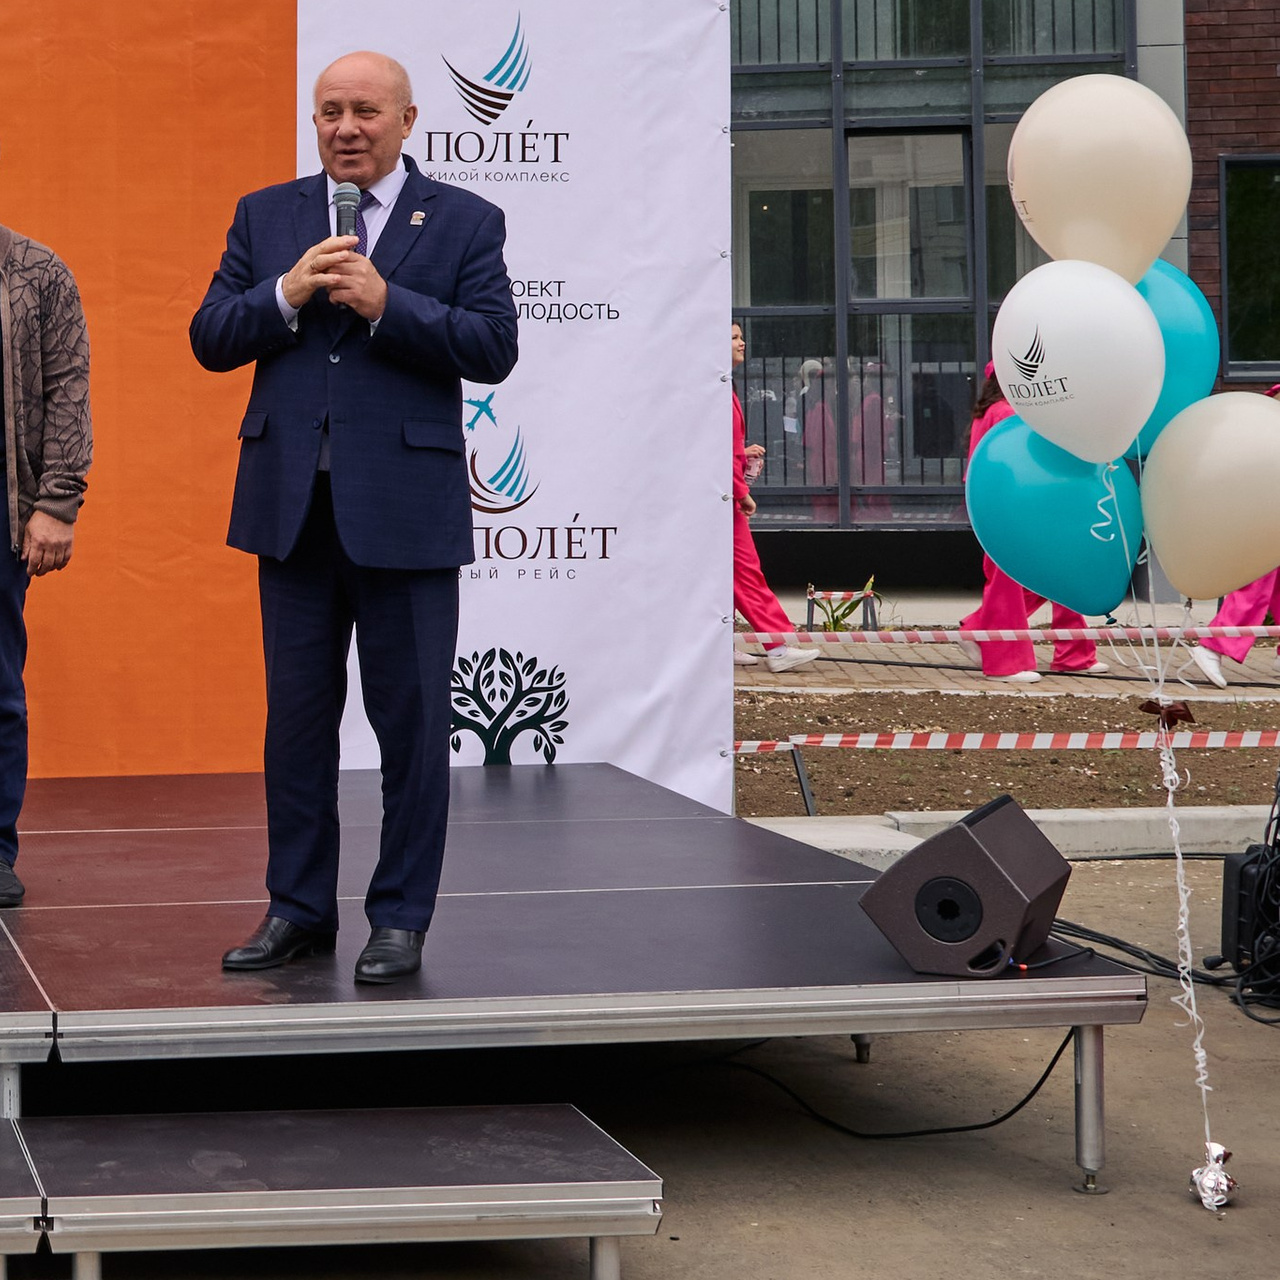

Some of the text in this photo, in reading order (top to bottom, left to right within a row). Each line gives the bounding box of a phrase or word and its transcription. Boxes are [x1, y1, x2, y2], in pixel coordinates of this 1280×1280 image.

[510, 280, 566, 297] ОЕКТ
[517, 303, 620, 324] ЛОДОСТЬ
[518, 567, 577, 580] РЕЙС
